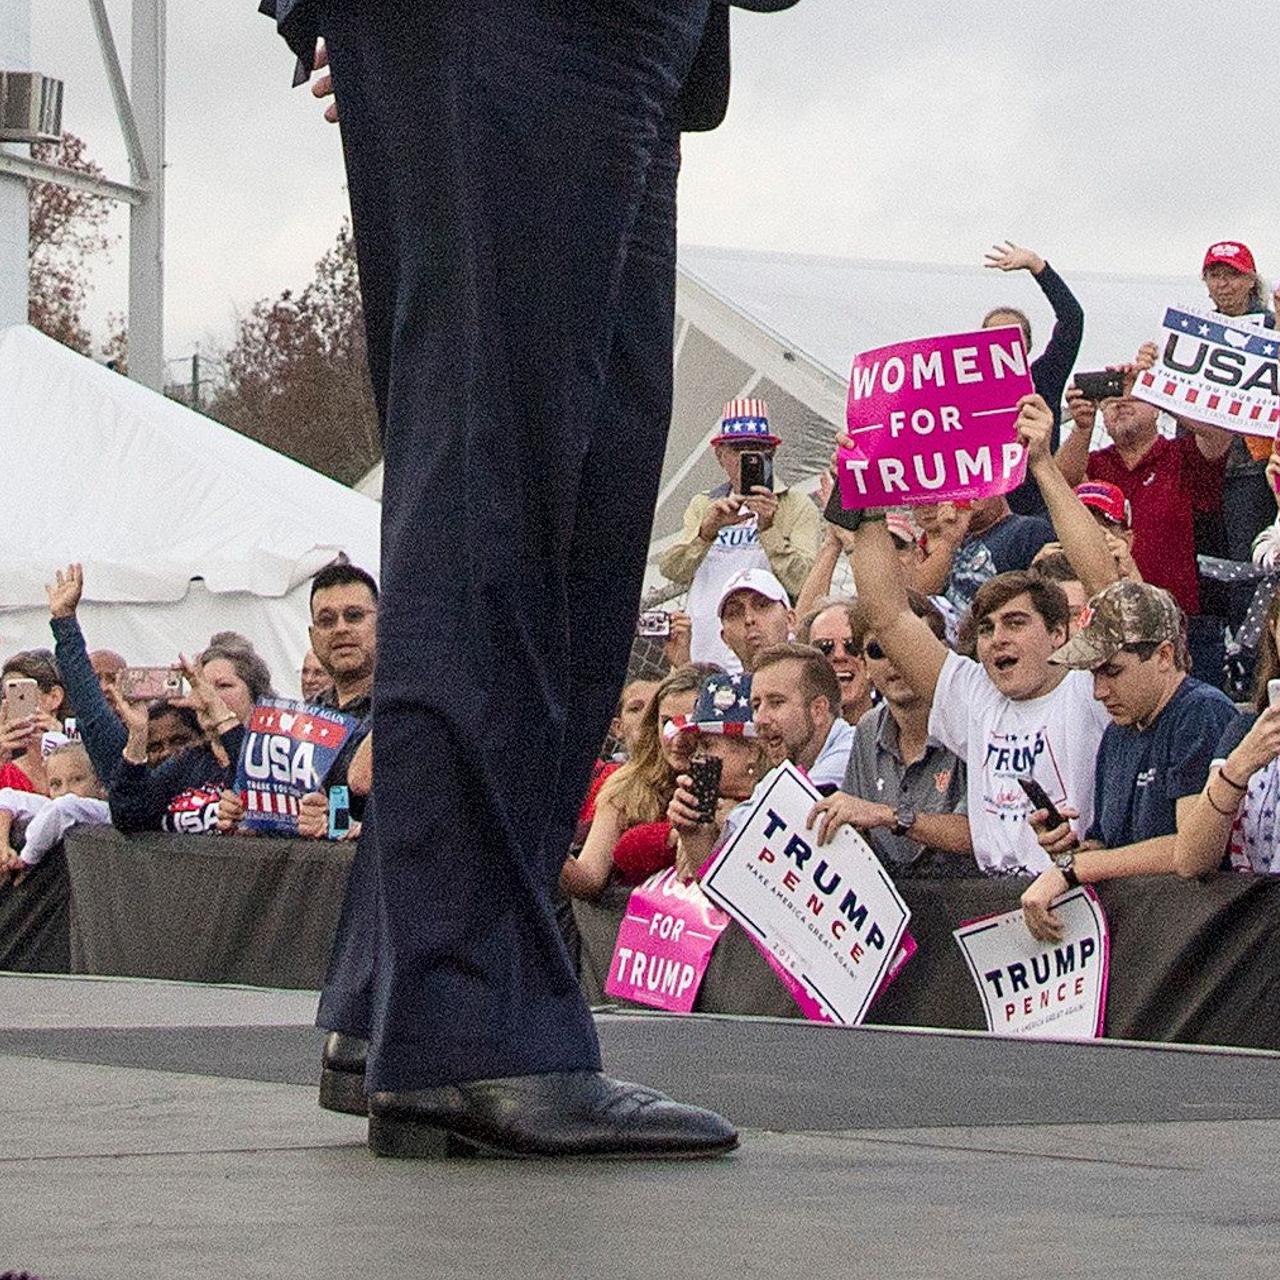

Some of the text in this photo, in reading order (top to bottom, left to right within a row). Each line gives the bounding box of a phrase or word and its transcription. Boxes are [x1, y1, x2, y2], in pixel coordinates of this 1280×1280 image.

[852, 341, 1027, 401] WOMEN
[1158, 370, 1192, 385] THANK
[1199, 382, 1220, 393] YOU
[1225, 391, 1252, 403] TOUR
[1163, 332, 1280, 396] USA
[890, 406, 963, 437] FOR
[846, 442, 1024, 495] TRUMP
[245, 732, 319, 789] USA
[758, 846, 865, 964] PENCE
[763, 808, 885, 951] TRUMP
[649, 912, 685, 942] FOR
[746, 862, 770, 887] MAKE
[770, 884, 807, 924] AMERICA
[807, 922, 834, 954] GREAT
[616, 947, 695, 998] TRUMP
[771, 941, 798, 970] 2016
[985, 937, 1095, 998] TRUMP
[1005, 977, 1085, 1022] PENCE
